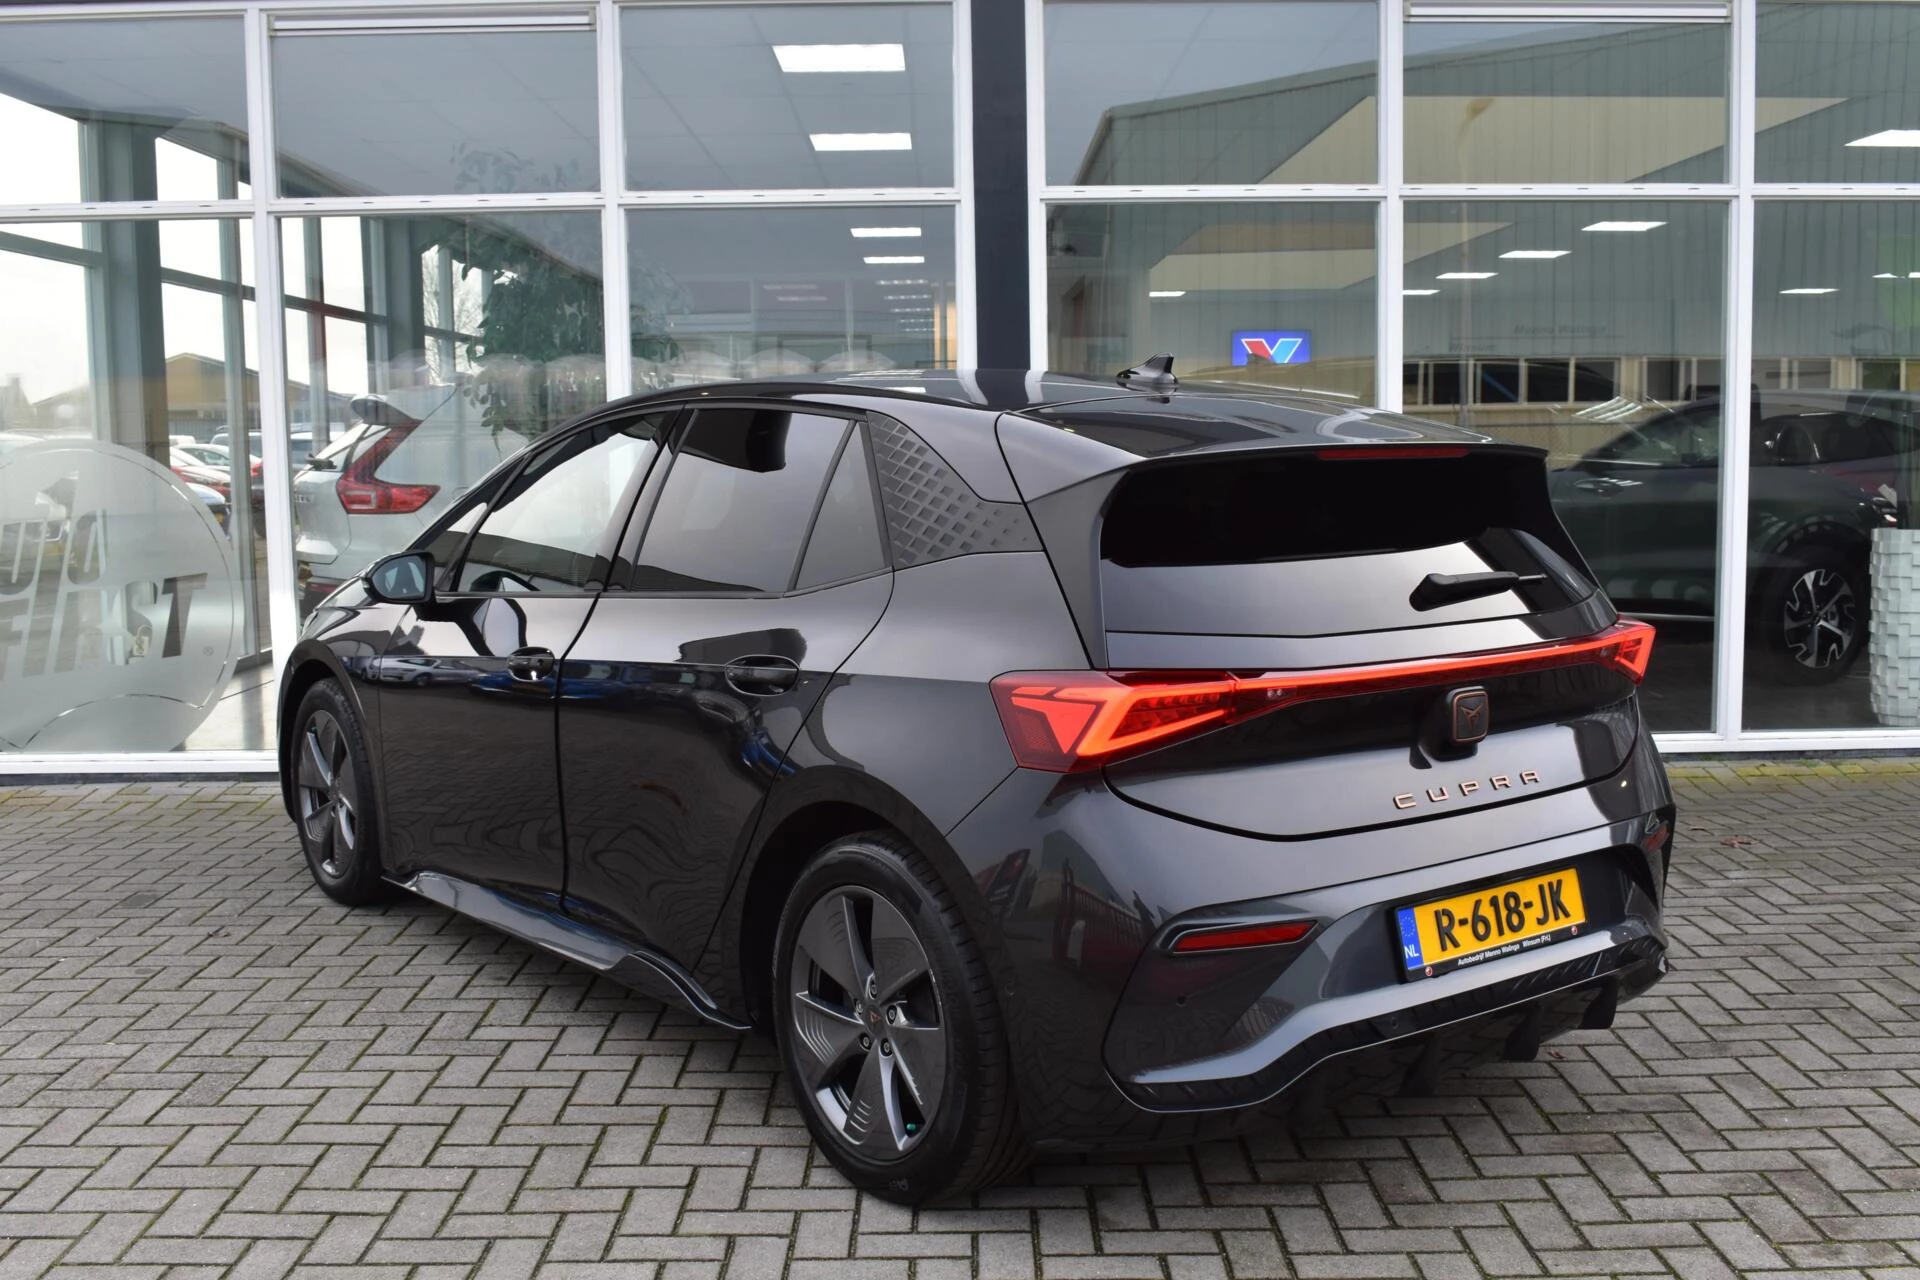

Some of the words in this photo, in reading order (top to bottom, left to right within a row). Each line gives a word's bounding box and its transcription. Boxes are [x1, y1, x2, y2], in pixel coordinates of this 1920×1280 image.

[1393, 770, 1540, 809] CUPRA
[1404, 945, 1420, 959] NL
[1434, 879, 1571, 952] R-618-JK
[1458, 952, 1484, 965] Autobedrijf
